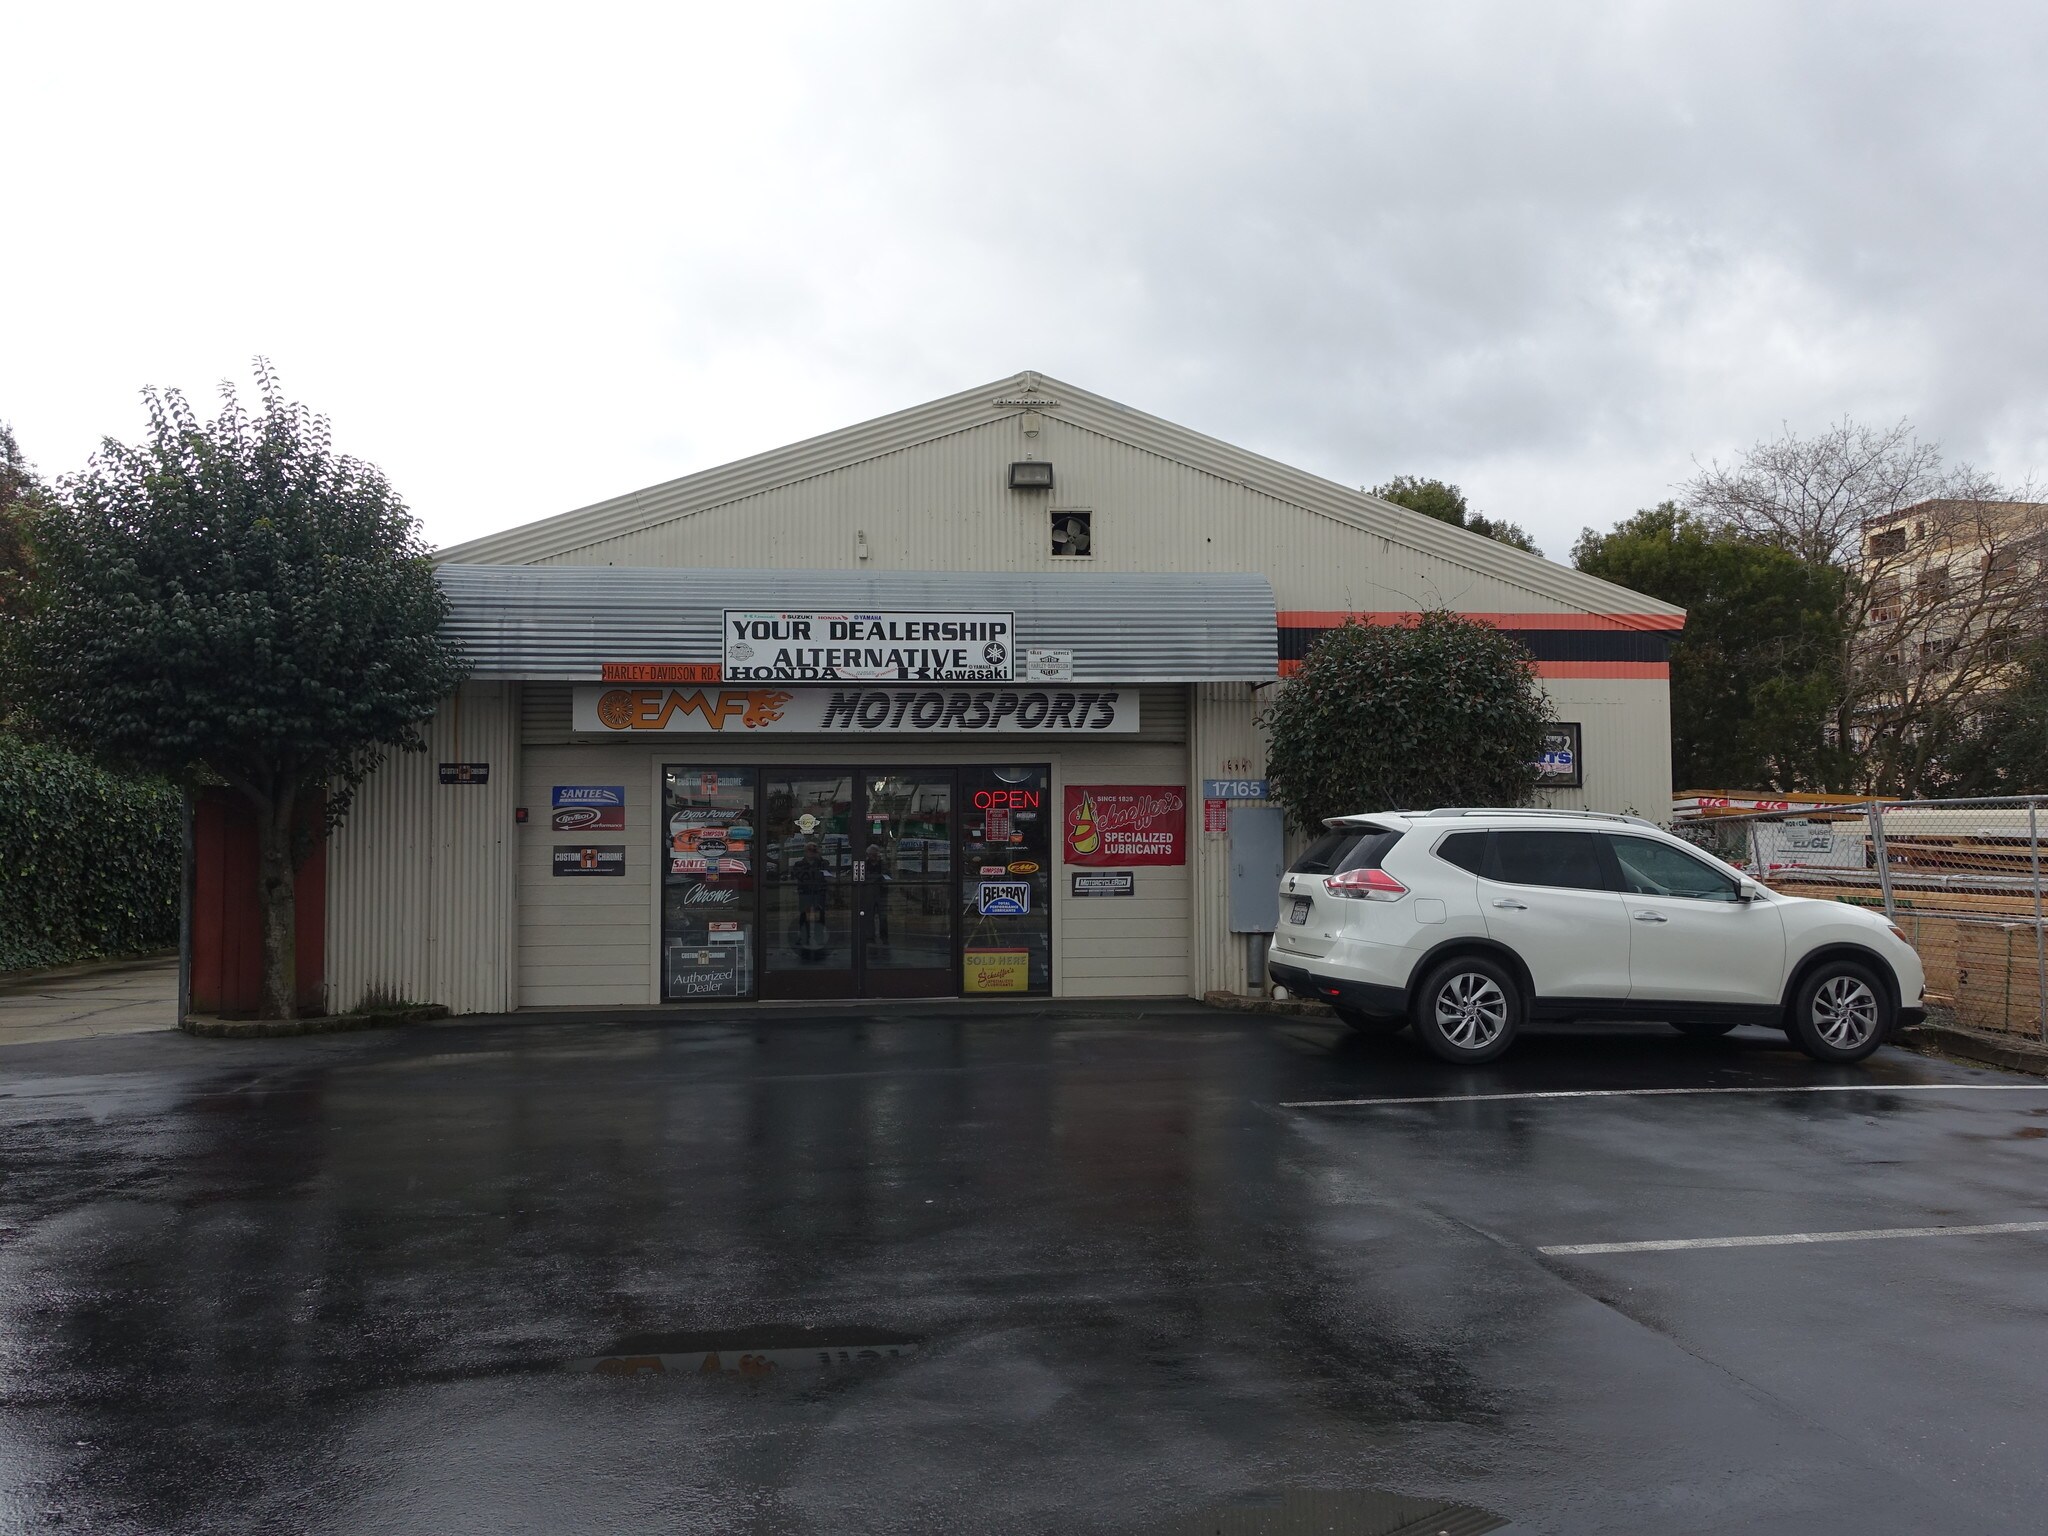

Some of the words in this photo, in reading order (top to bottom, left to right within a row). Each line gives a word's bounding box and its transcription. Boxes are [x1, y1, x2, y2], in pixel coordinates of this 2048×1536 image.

[732, 621, 811, 640] YOUR
[829, 621, 1007, 641] DEALERSHIP
[772, 648, 968, 668] ALTERNATIVE
[607, 666, 695, 680] HARLEY-DAVIDSON
[701, 667, 717, 680] RD.
[729, 666, 842, 680] HONDA
[933, 666, 1007, 680] Kawasaki
[631, 689, 749, 729] EMF
[819, 692, 1119, 729] MOTORSPORTS
[677, 777, 702, 786] CUSTOM
[717, 777, 742, 786] CHROME
[560, 789, 602, 799] SANTEE
[1212, 781, 1261, 797] 17165
[973, 790, 1039, 809] OPEN
[678, 810, 706, 820] Dyno
[706, 810, 739, 819] Power
[1068, 792, 1183, 844] Schaeffer's
[1104, 832, 1174, 843] SPECIALIZED
[1104, 844, 1173, 855] LUBRICANTS
[555, 852, 581, 862] CUSTOM
[597, 852, 623, 862] CHROME
[982, 866, 1004, 874] SIMPSON
[966, 956, 996, 966] SOLD
[998, 956, 1027, 966] HERE
[673, 968, 734, 985] Authorized
[687, 981, 723, 994] Dealer
